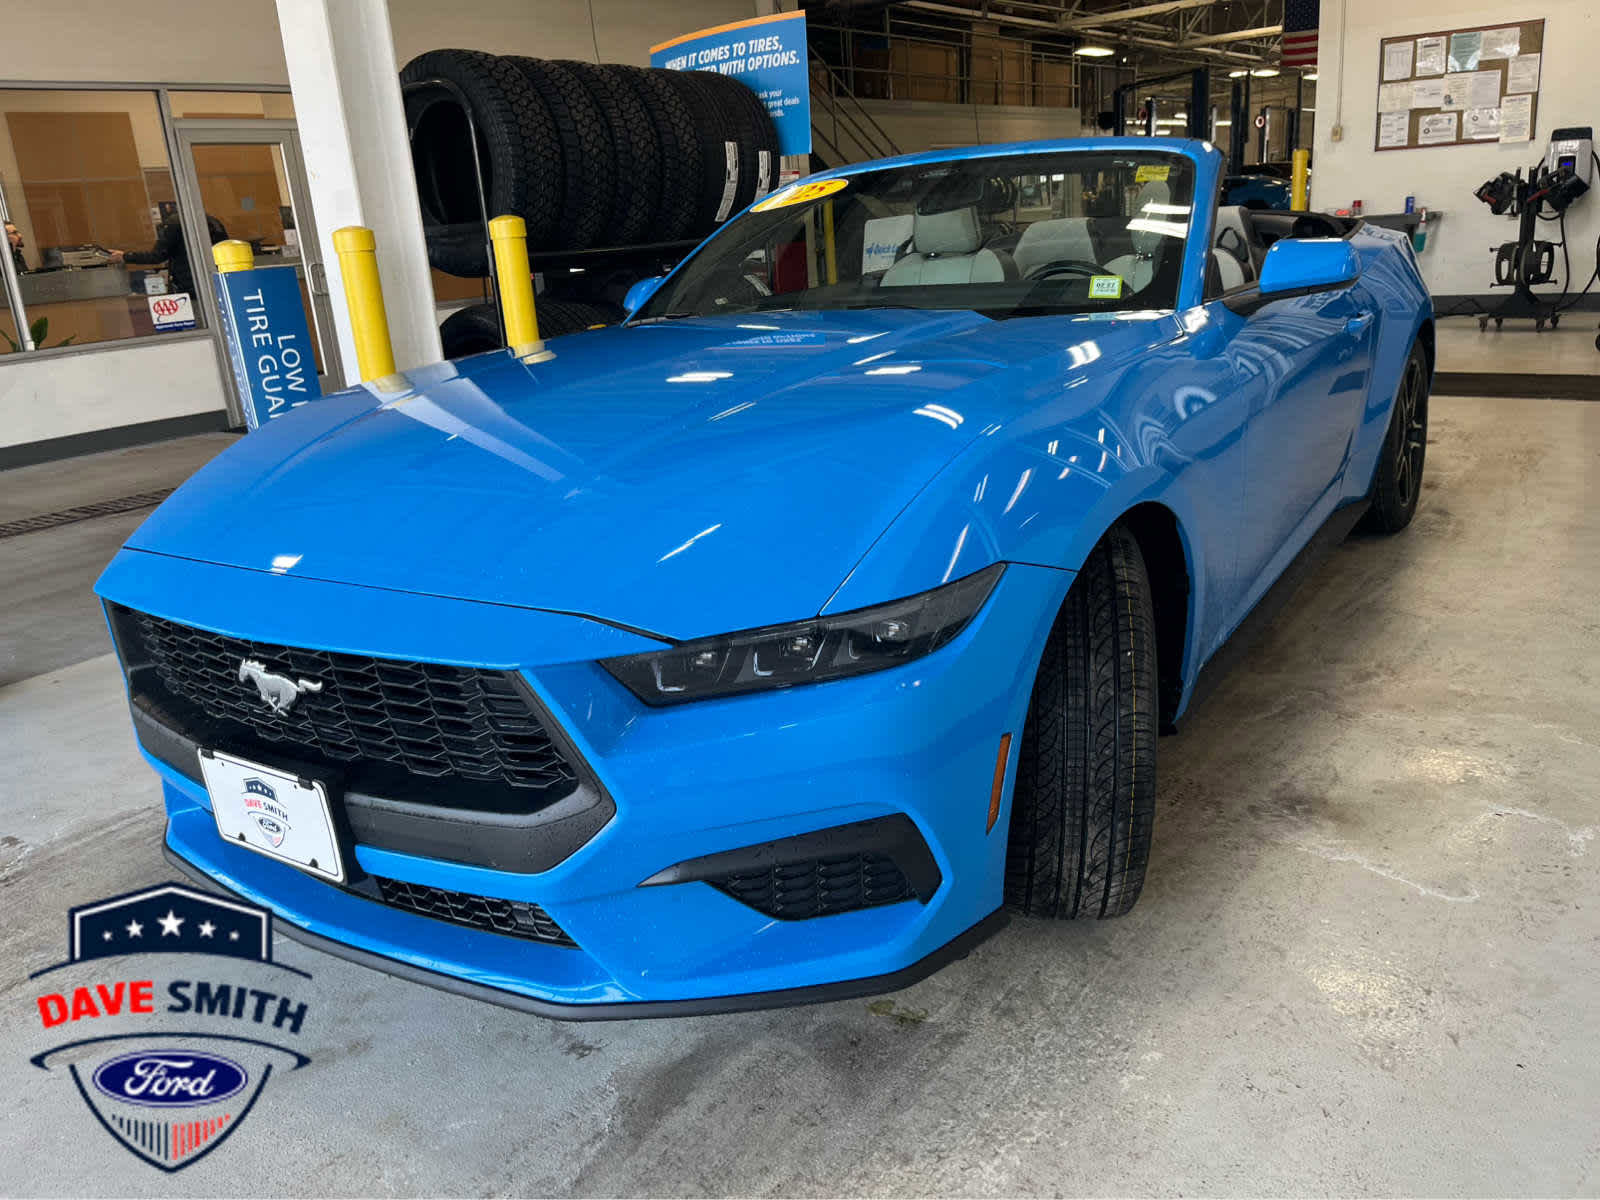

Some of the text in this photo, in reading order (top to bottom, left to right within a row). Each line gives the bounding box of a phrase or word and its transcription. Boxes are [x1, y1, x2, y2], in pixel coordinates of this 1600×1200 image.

[665, 56, 687, 71] WHEN
[688, 53, 697, 67] IT
[698, 45, 730, 65] COMES
[732, 42, 746, 57] TO
[748, 35, 783, 54] TIRES,
[719, 58, 746, 75] WITH
[747, 50, 800, 71] OPTIONS.
[767, 96, 800, 109] great deals
[769, 89, 783, 99] your
[153, 299, 179, 316] AAA
[243, 288, 285, 419] TIRE GUA
[277, 334, 308, 392] LOW
[263, 801, 288, 822] SMITH
